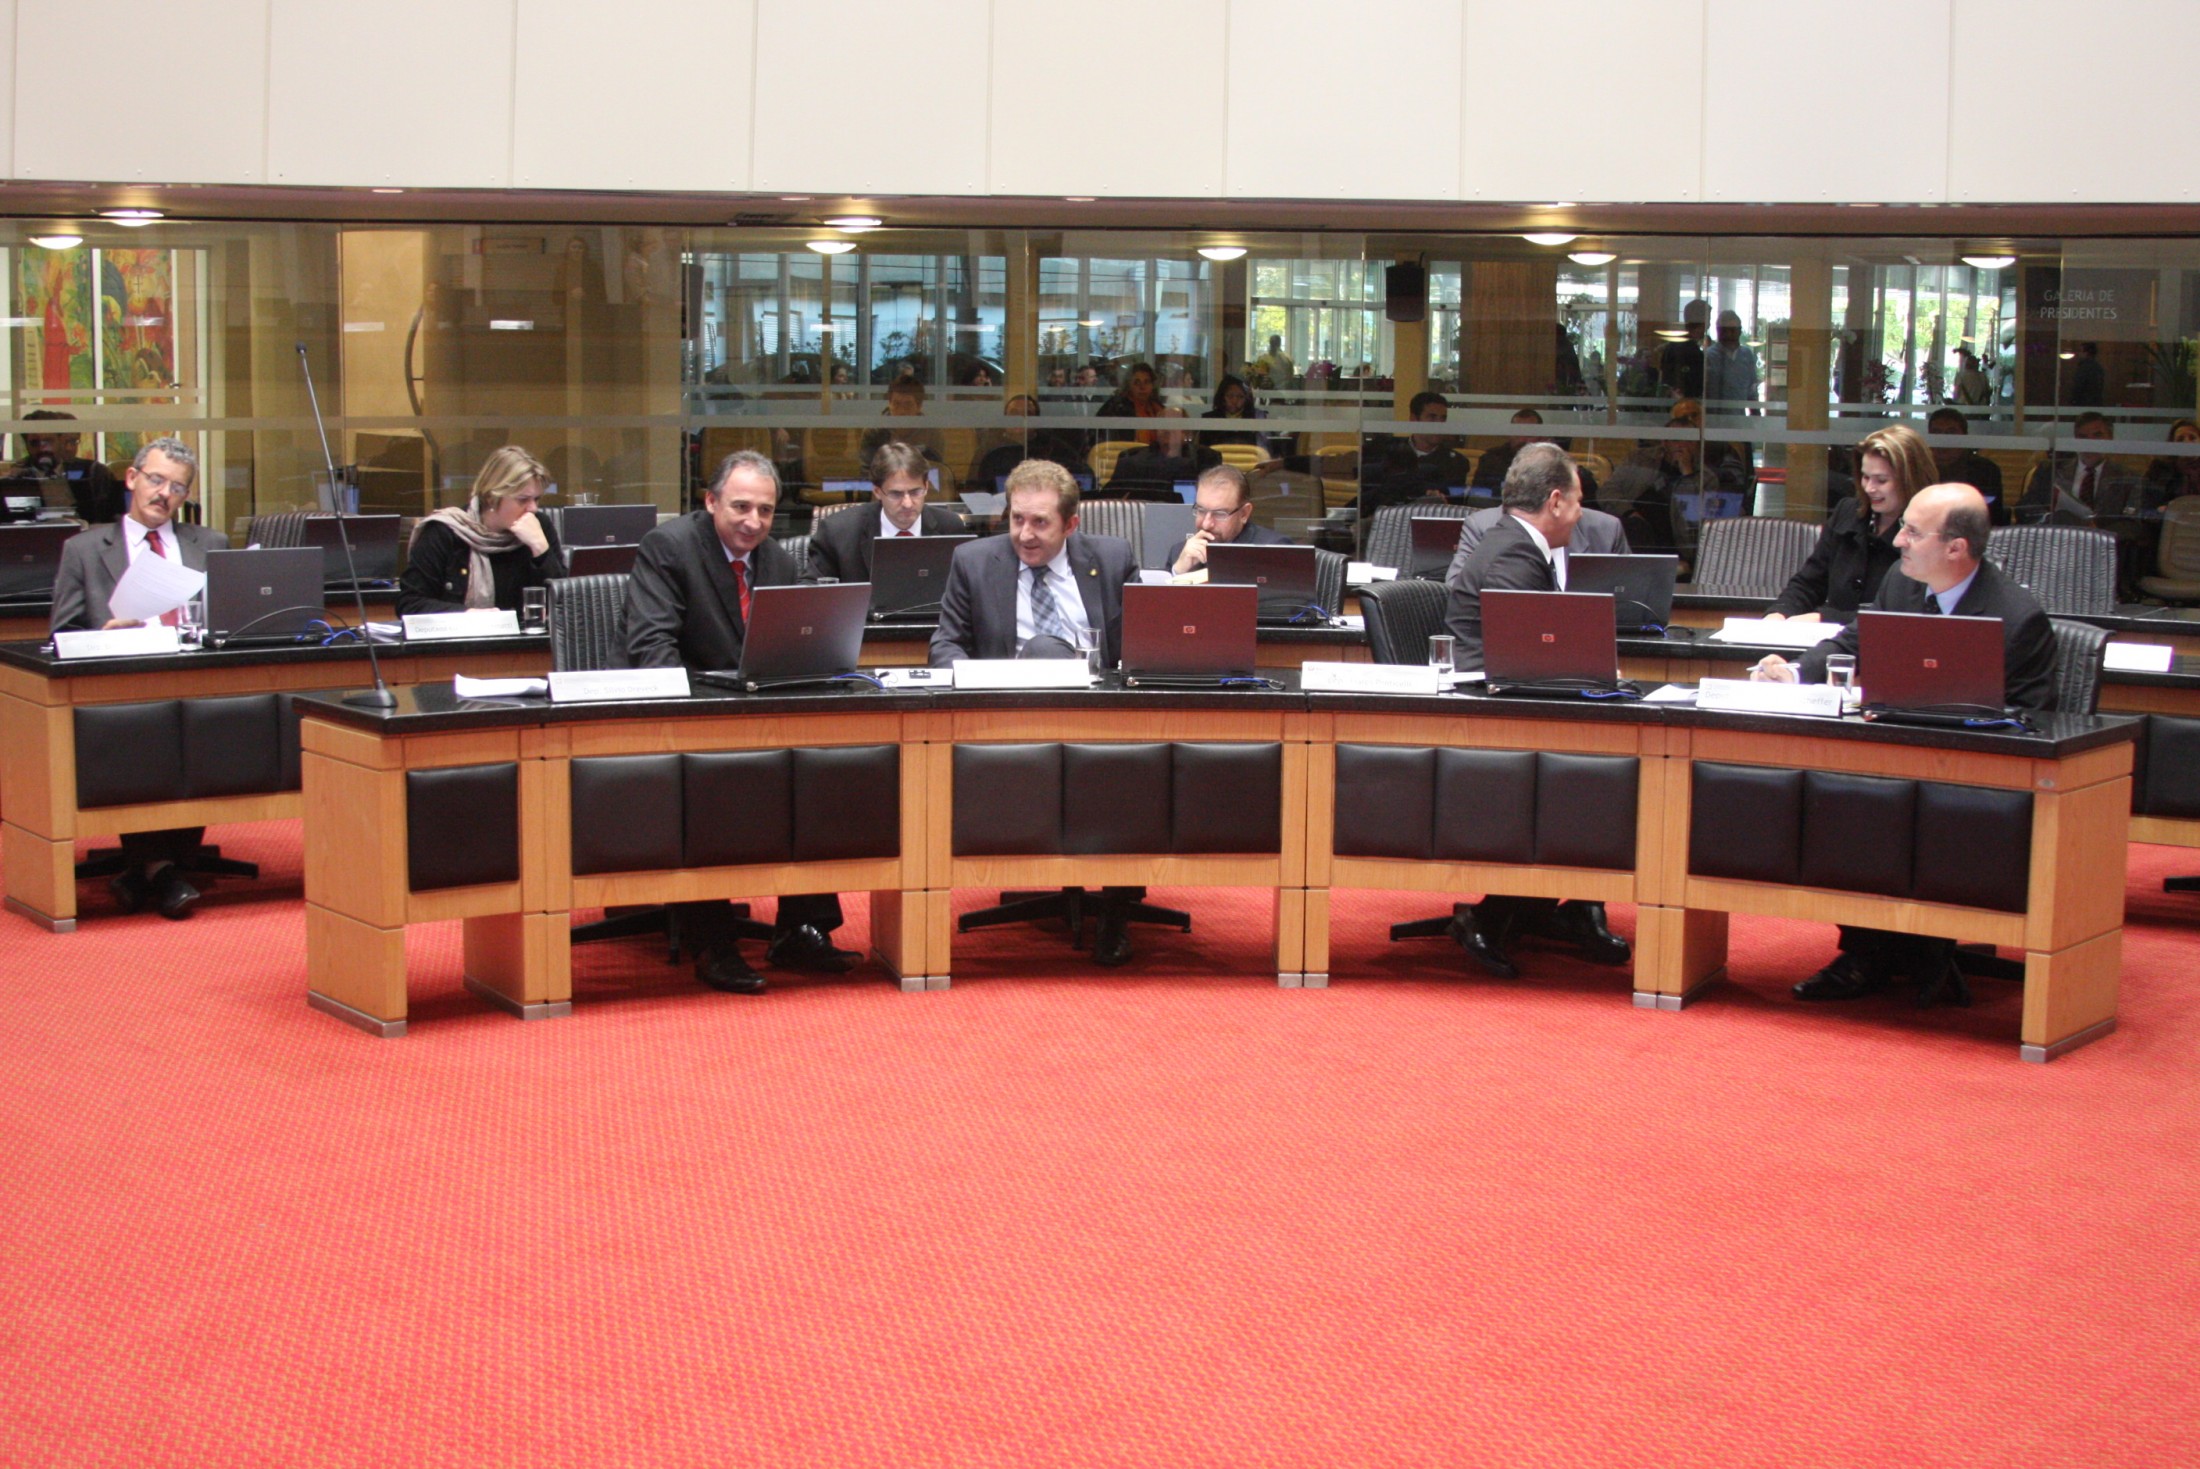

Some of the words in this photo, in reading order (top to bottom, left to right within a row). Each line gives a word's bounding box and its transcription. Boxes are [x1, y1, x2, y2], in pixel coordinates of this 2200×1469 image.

[2043, 289, 2094, 302] GALERIA
[2099, 289, 2115, 302] DE
[2040, 306, 2118, 320] PRESIDENTES
